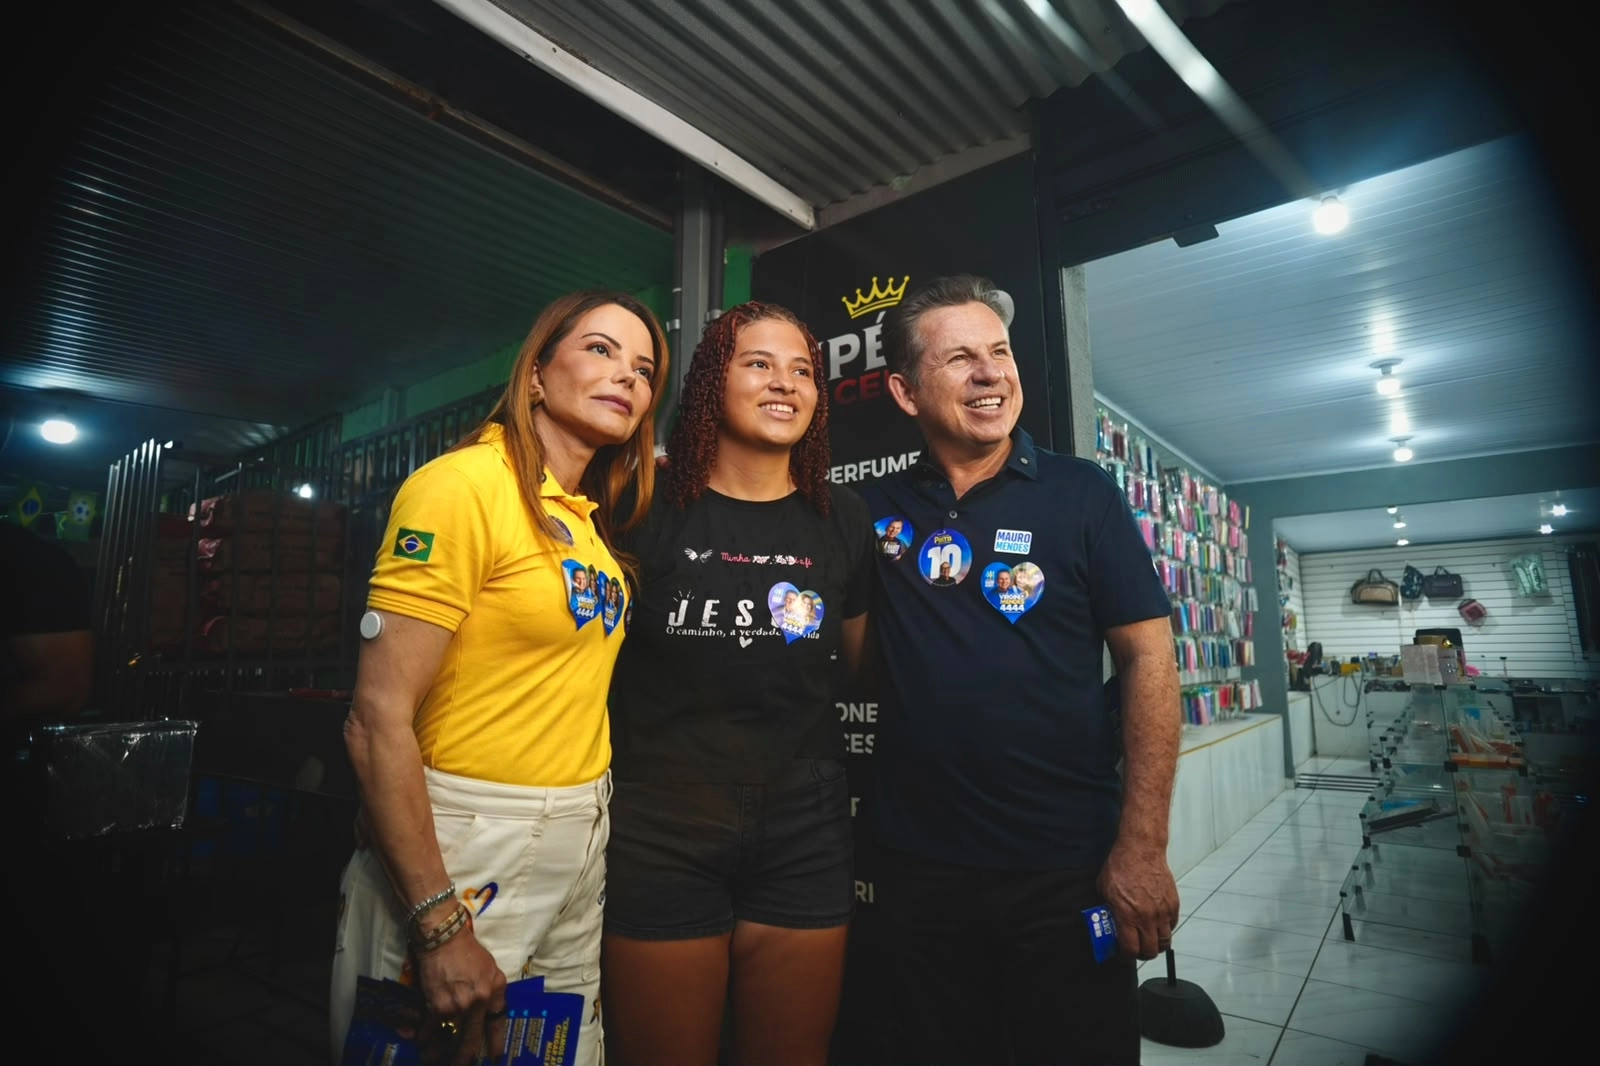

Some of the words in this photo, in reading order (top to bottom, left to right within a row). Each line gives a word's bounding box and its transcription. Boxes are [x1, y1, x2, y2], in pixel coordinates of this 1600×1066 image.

[817, 310, 888, 382] PÉ
[997, 531, 1031, 543] MAURO
[996, 541, 1029, 553] MENDES
[927, 543, 962, 580] 10
[667, 599, 779, 629] JES
[999, 604, 1025, 612] 4444
[665, 626, 675, 636] O
[676, 627, 727, 639] caminho,
[729, 628, 737, 637] a
